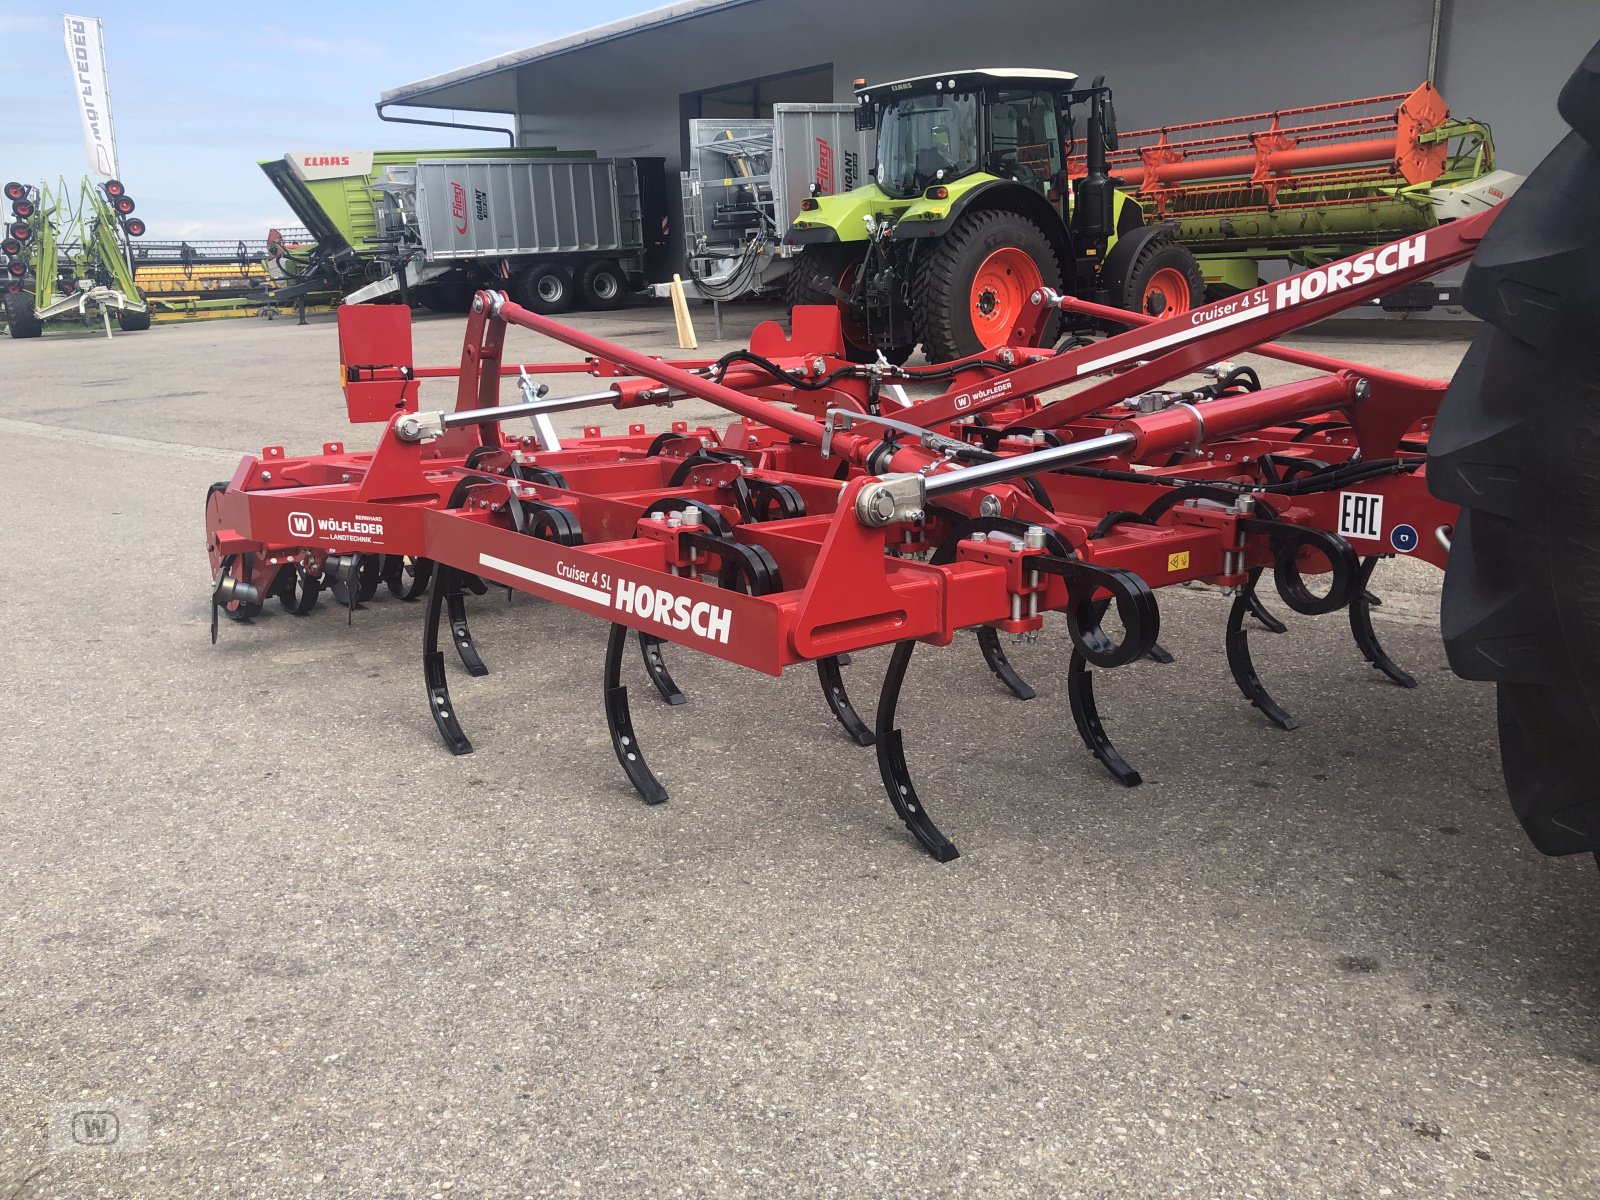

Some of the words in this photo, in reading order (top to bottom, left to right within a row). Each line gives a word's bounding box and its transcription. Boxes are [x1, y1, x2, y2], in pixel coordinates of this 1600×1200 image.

[891, 82, 913, 91] CLAAS
[304, 157, 350, 166] CLAAS
[844, 150, 853, 192] IGANT
[475, 188, 484, 221] GIGANT
[1276, 235, 1427, 310] HORSCH
[1191, 303, 1237, 326] Cruiser
[1241, 295, 1250, 308] 4
[1253, 289, 1269, 305] SL
[972, 382, 1012, 400] WÖLFLEDER
[317, 518, 384, 535] WÖLFLEDER
[355, 514, 383, 522] BERNHARD
[1341, 494, 1380, 536] EAC
[329, 533, 373, 543] LANDTECHNIK
[556, 560, 590, 585] Cruiser
[591, 571, 599, 586] 4
[601, 573, 612, 591] SL
[615, 578, 733, 645] HORSCH
